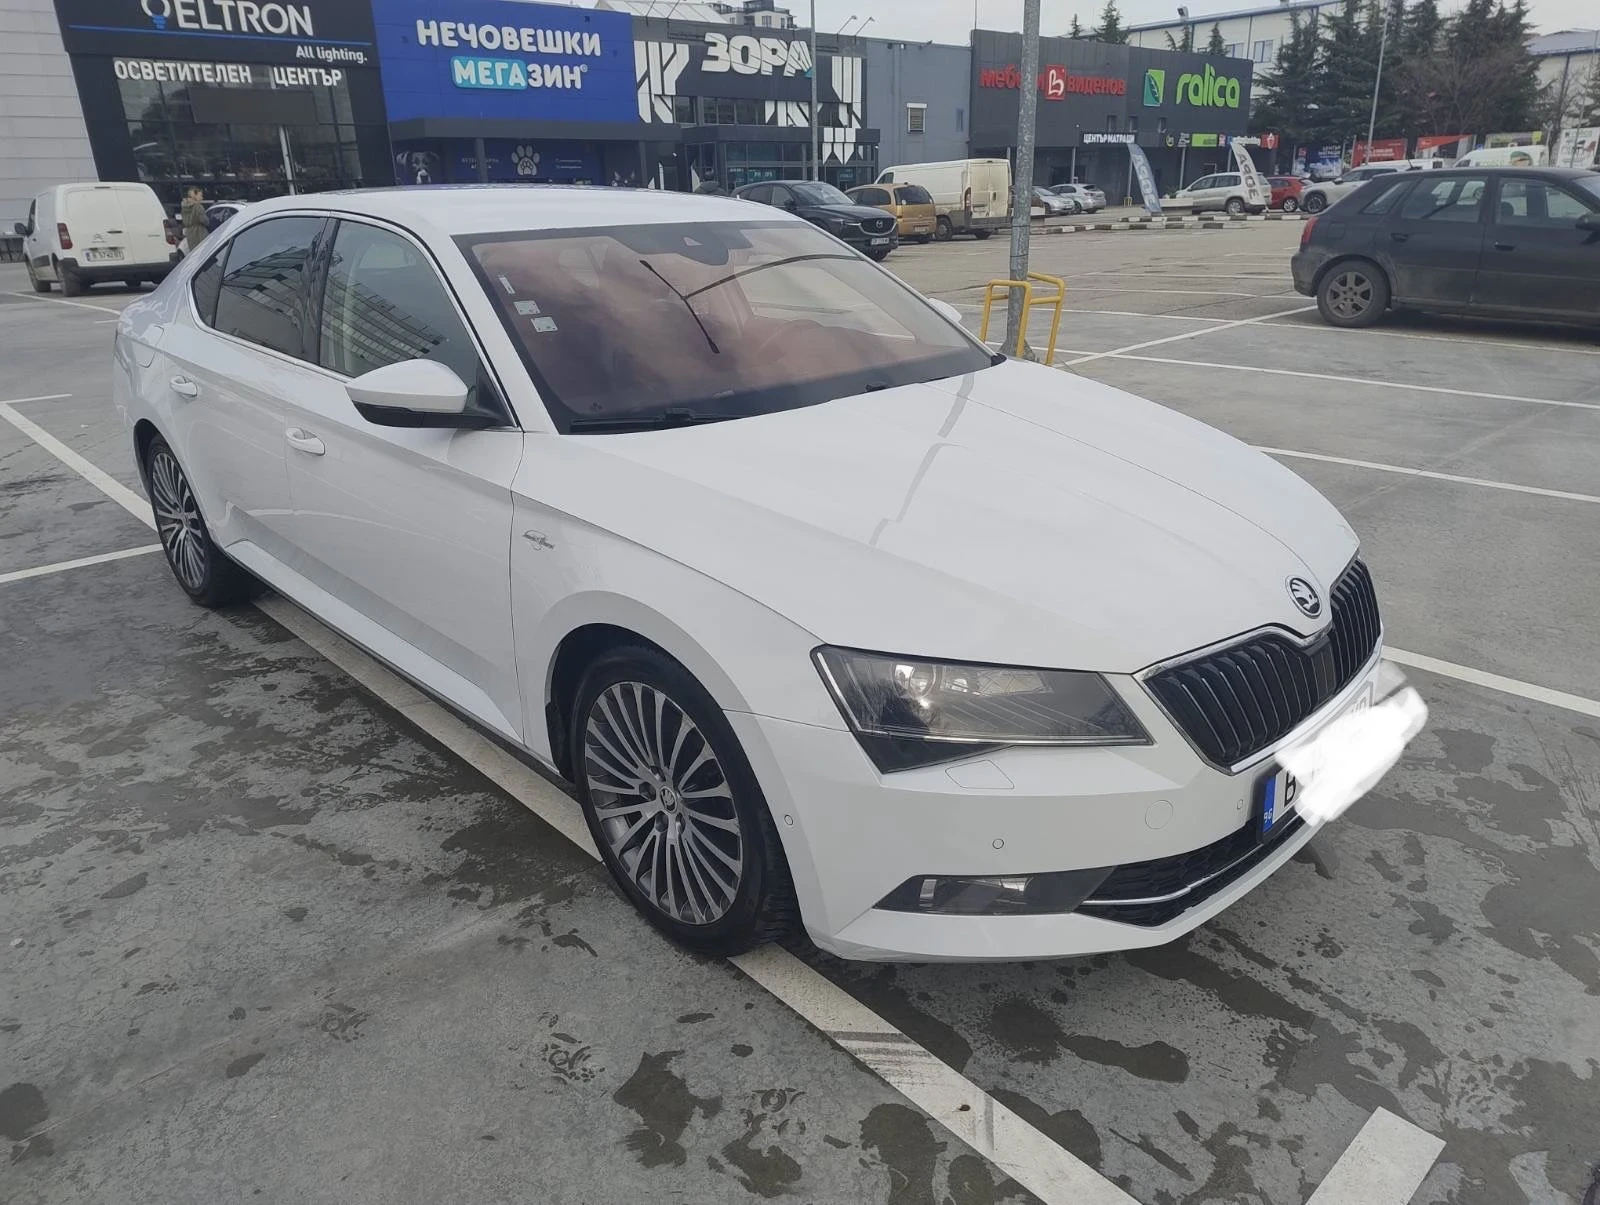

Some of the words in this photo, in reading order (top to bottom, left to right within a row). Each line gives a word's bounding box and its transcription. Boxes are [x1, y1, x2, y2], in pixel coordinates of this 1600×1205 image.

[296, 45, 315, 58] All
[316, 46, 367, 64] lighting.
[416, 20, 601, 56] НЕЧОВЕШКИ
[701, 32, 812, 77] ЗОРА
[114, 60, 252, 83] ОСВЕТИТЕЛЕН
[272, 66, 342, 86] ЦЕНТЪР
[1176, 62, 1240, 108] ralica
